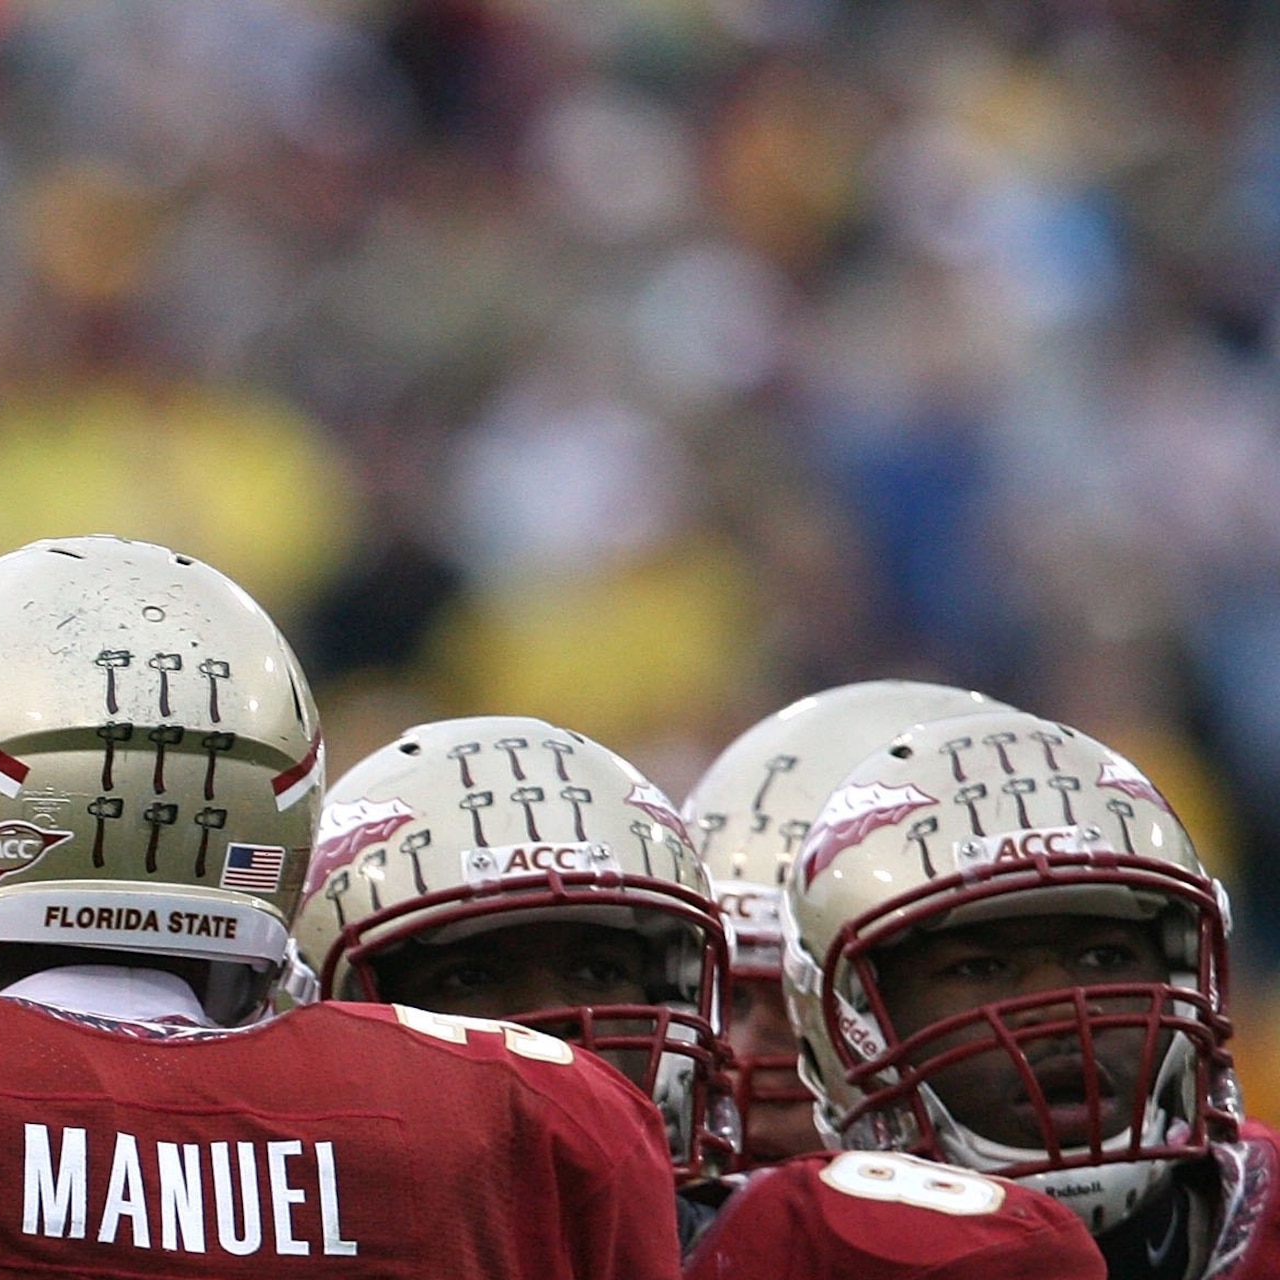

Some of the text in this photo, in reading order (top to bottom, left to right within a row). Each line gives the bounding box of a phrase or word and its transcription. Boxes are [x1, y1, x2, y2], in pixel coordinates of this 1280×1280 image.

[504, 846, 576, 873] ACC
[994, 831, 1066, 863] ACC
[719, 893, 757, 918] CC
[43, 905, 238, 940] FLORIDA STATE
[21, 1122, 358, 1256] MANUEL
